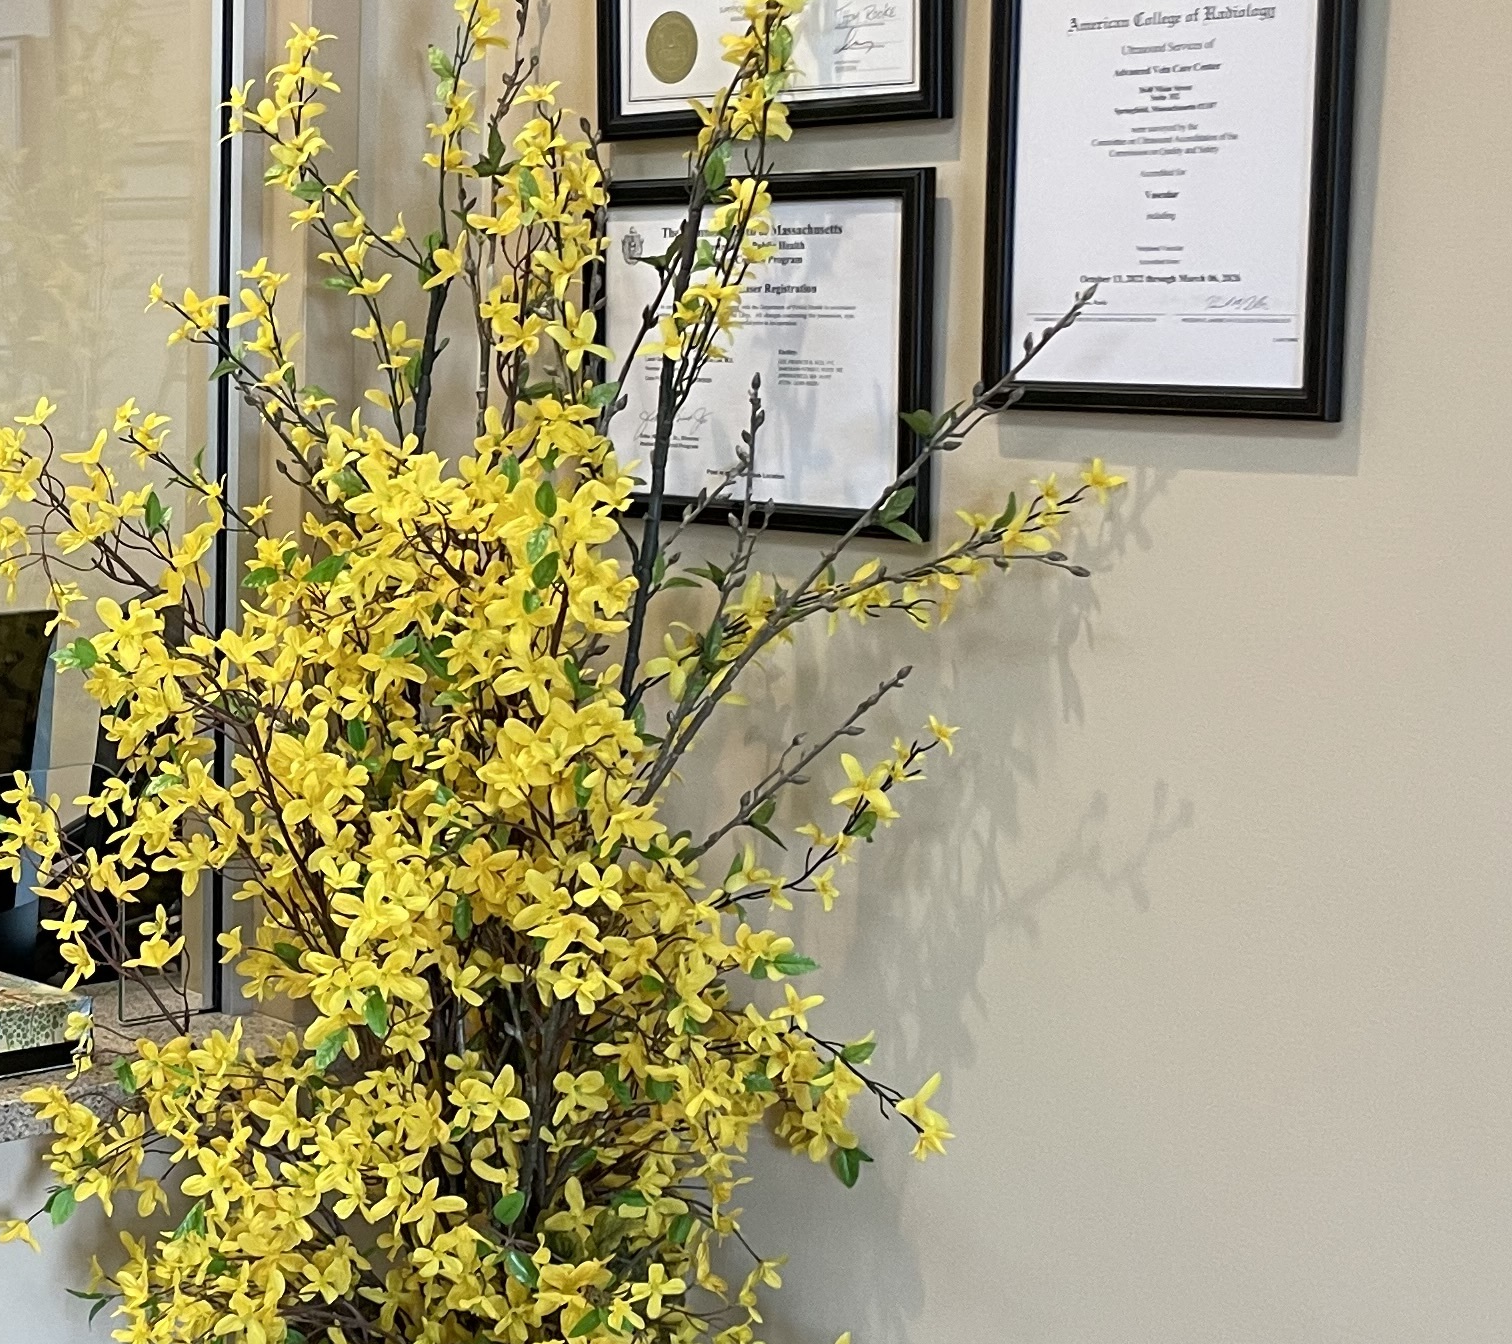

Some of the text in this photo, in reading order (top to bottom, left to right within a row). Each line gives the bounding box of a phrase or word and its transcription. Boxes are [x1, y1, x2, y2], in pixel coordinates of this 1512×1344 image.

[1067, 16, 1129, 34] American
[1133, 11, 1181, 28] College
[1185, 8, 1200, 23] of
[764, 283, 817, 295] Registration
